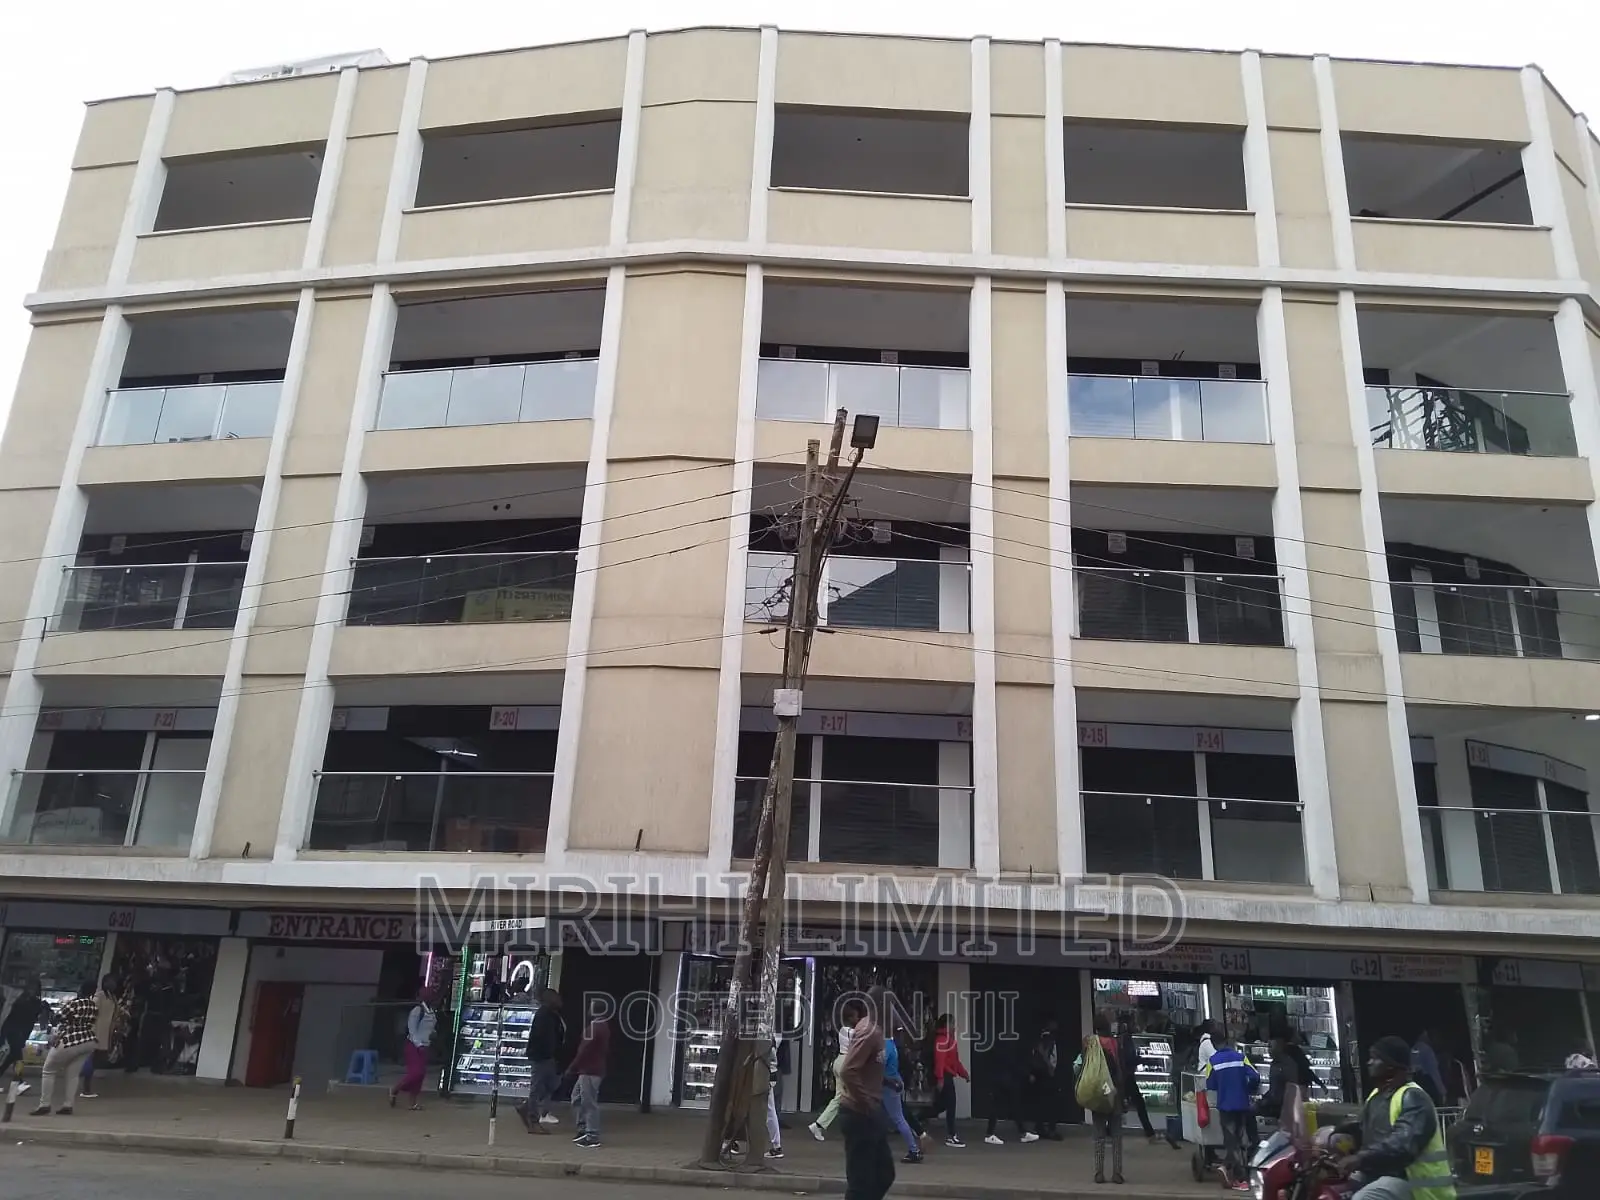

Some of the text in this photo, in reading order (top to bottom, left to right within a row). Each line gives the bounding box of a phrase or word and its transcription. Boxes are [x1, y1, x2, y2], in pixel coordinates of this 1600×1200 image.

[820, 715, 844, 731] F-17
[1080, 727, 1104, 744] F-15
[1196, 732, 1220, 748] F-14
[108, 910, 131, 928] G-20
[268, 913, 403, 940] ENTRANCE
[490, 919, 523, 930] RIVER ROAD
[1350, 957, 1378, 975] G-12
